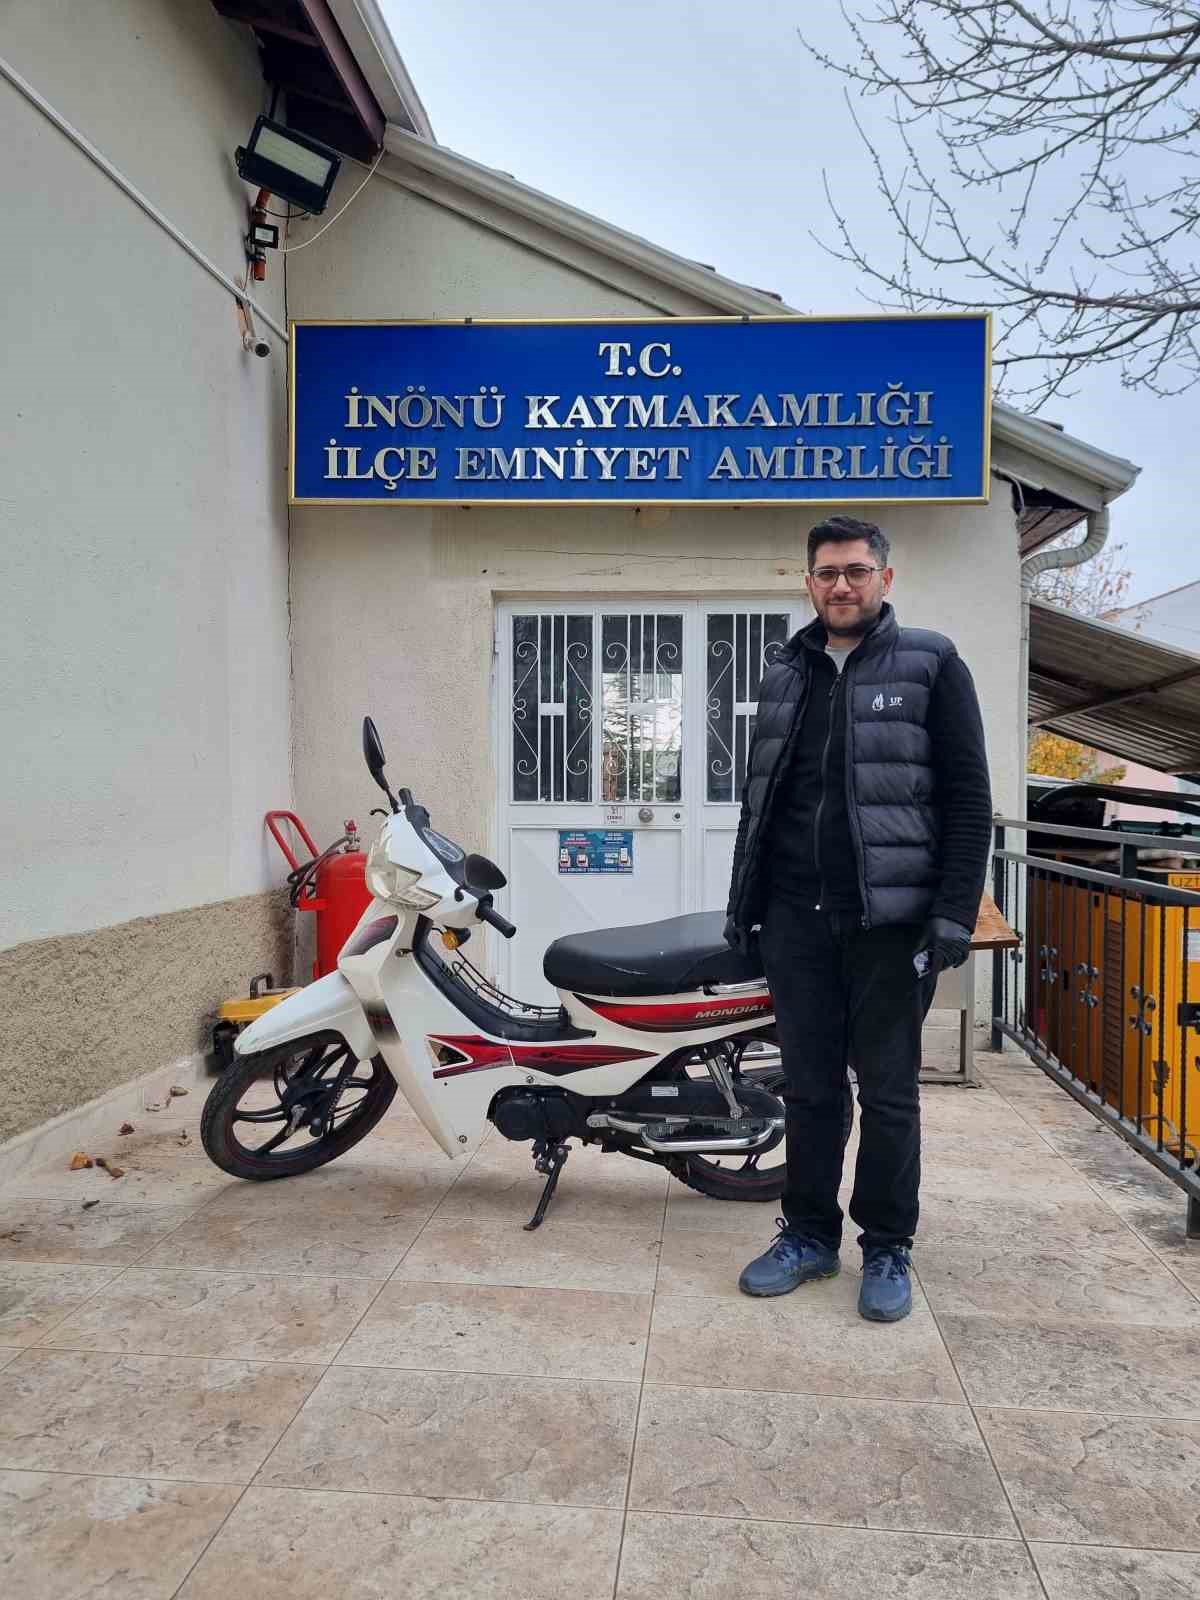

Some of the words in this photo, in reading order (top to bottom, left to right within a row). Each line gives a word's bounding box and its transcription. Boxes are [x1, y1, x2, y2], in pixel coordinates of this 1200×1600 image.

[598, 342, 682, 378] T.C.
[345, 385, 506, 429] İNÖNÜ
[524, 382, 934, 429] KAYMAKAMLIĞI
[324, 438, 437, 491] İLÇE
[454, 438, 690, 480] EMNİYET
[708, 435, 953, 480] AMİRLİĞİ
[695, 1003, 767, 1018] MONDIAL
